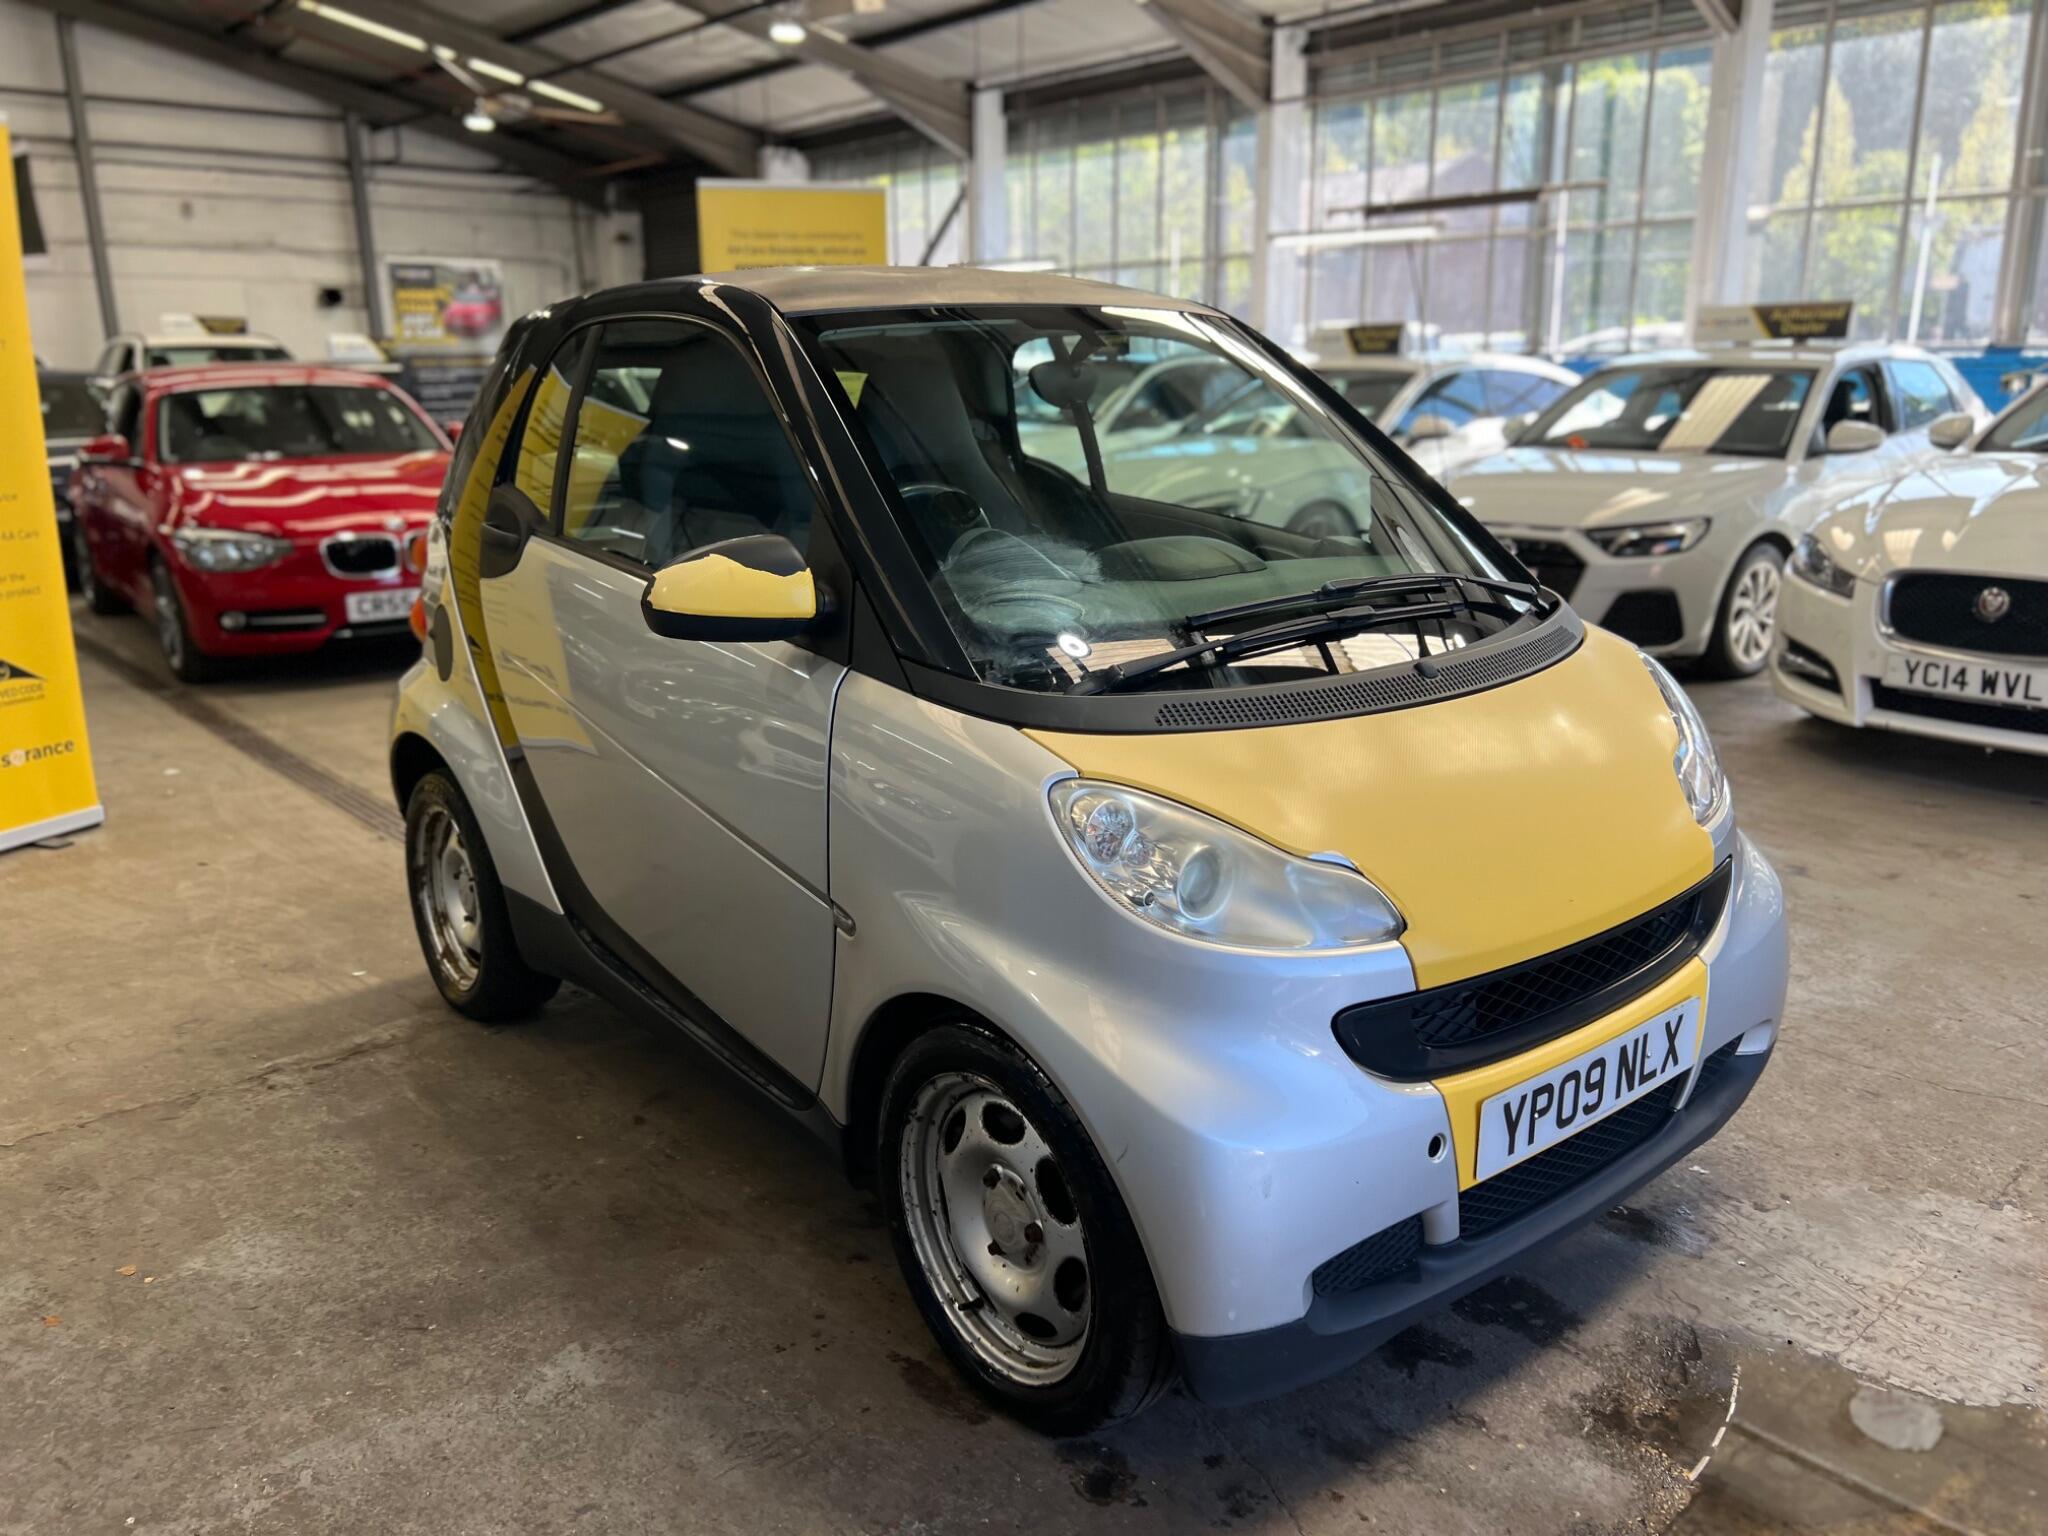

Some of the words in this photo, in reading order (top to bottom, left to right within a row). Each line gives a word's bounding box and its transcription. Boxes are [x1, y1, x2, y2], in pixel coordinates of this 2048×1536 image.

[1905, 659, 1968, 692] YC14
[1980, 669, 2042, 702] WVL
[1503, 1057, 1607, 1156] YP09
[1615, 1014, 1684, 1100] NLX
